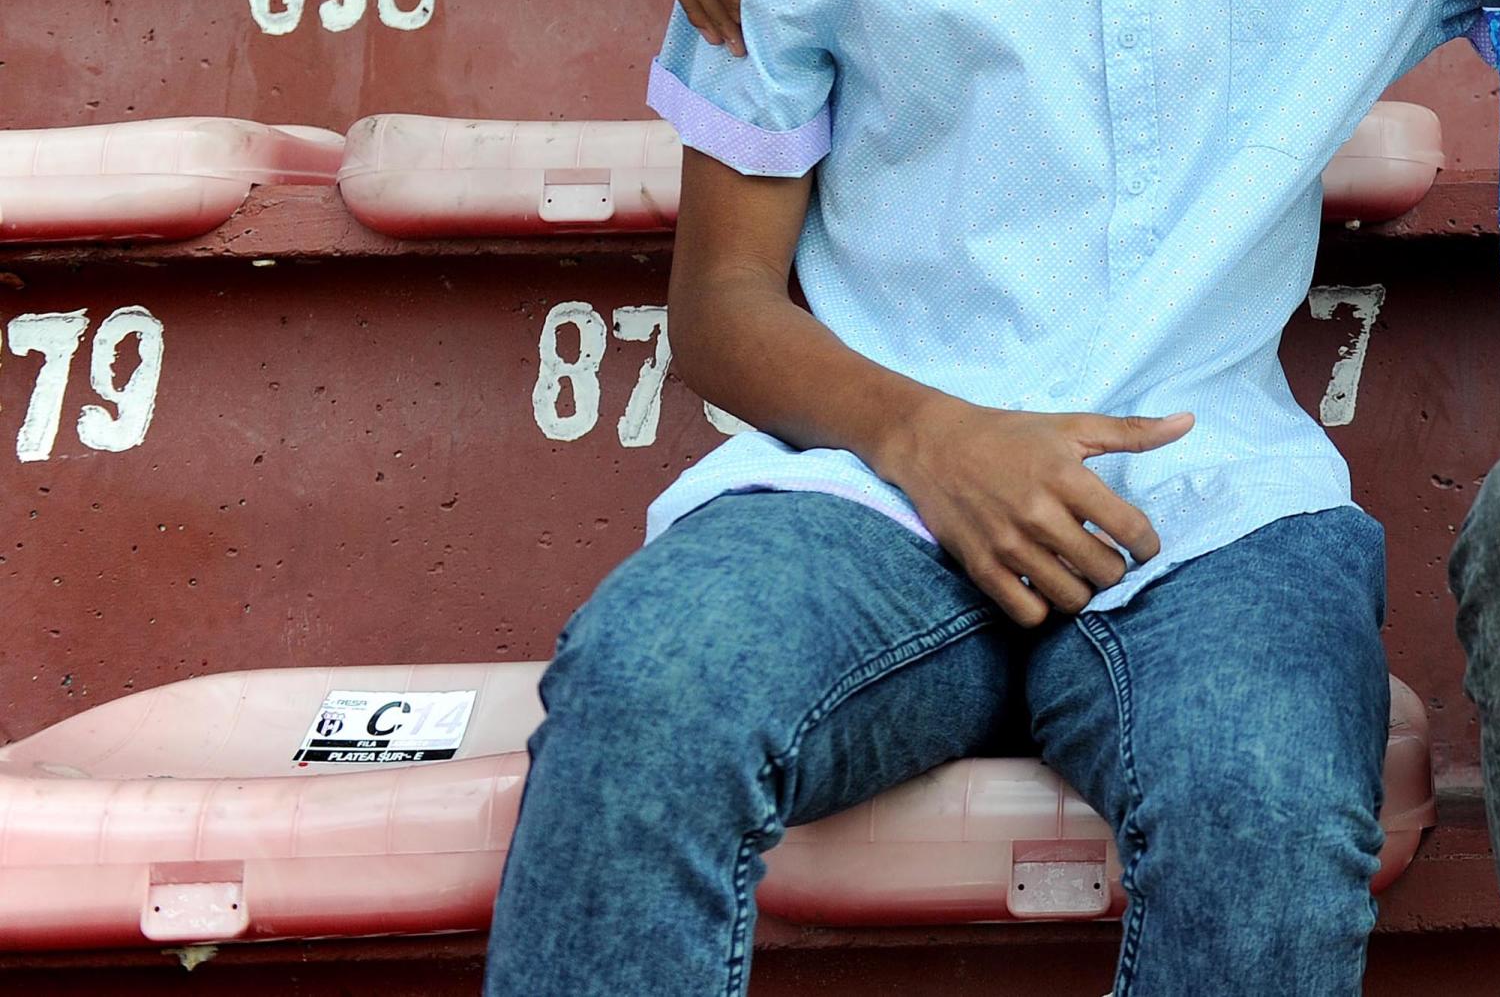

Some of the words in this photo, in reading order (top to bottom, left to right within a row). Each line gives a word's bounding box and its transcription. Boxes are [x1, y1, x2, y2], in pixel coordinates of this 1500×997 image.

[366, 700, 411, 737] C
[410, 702, 467, 736] 14
[356, 740, 377, 748] FILA
[327, 752, 376, 761] PLATEA
